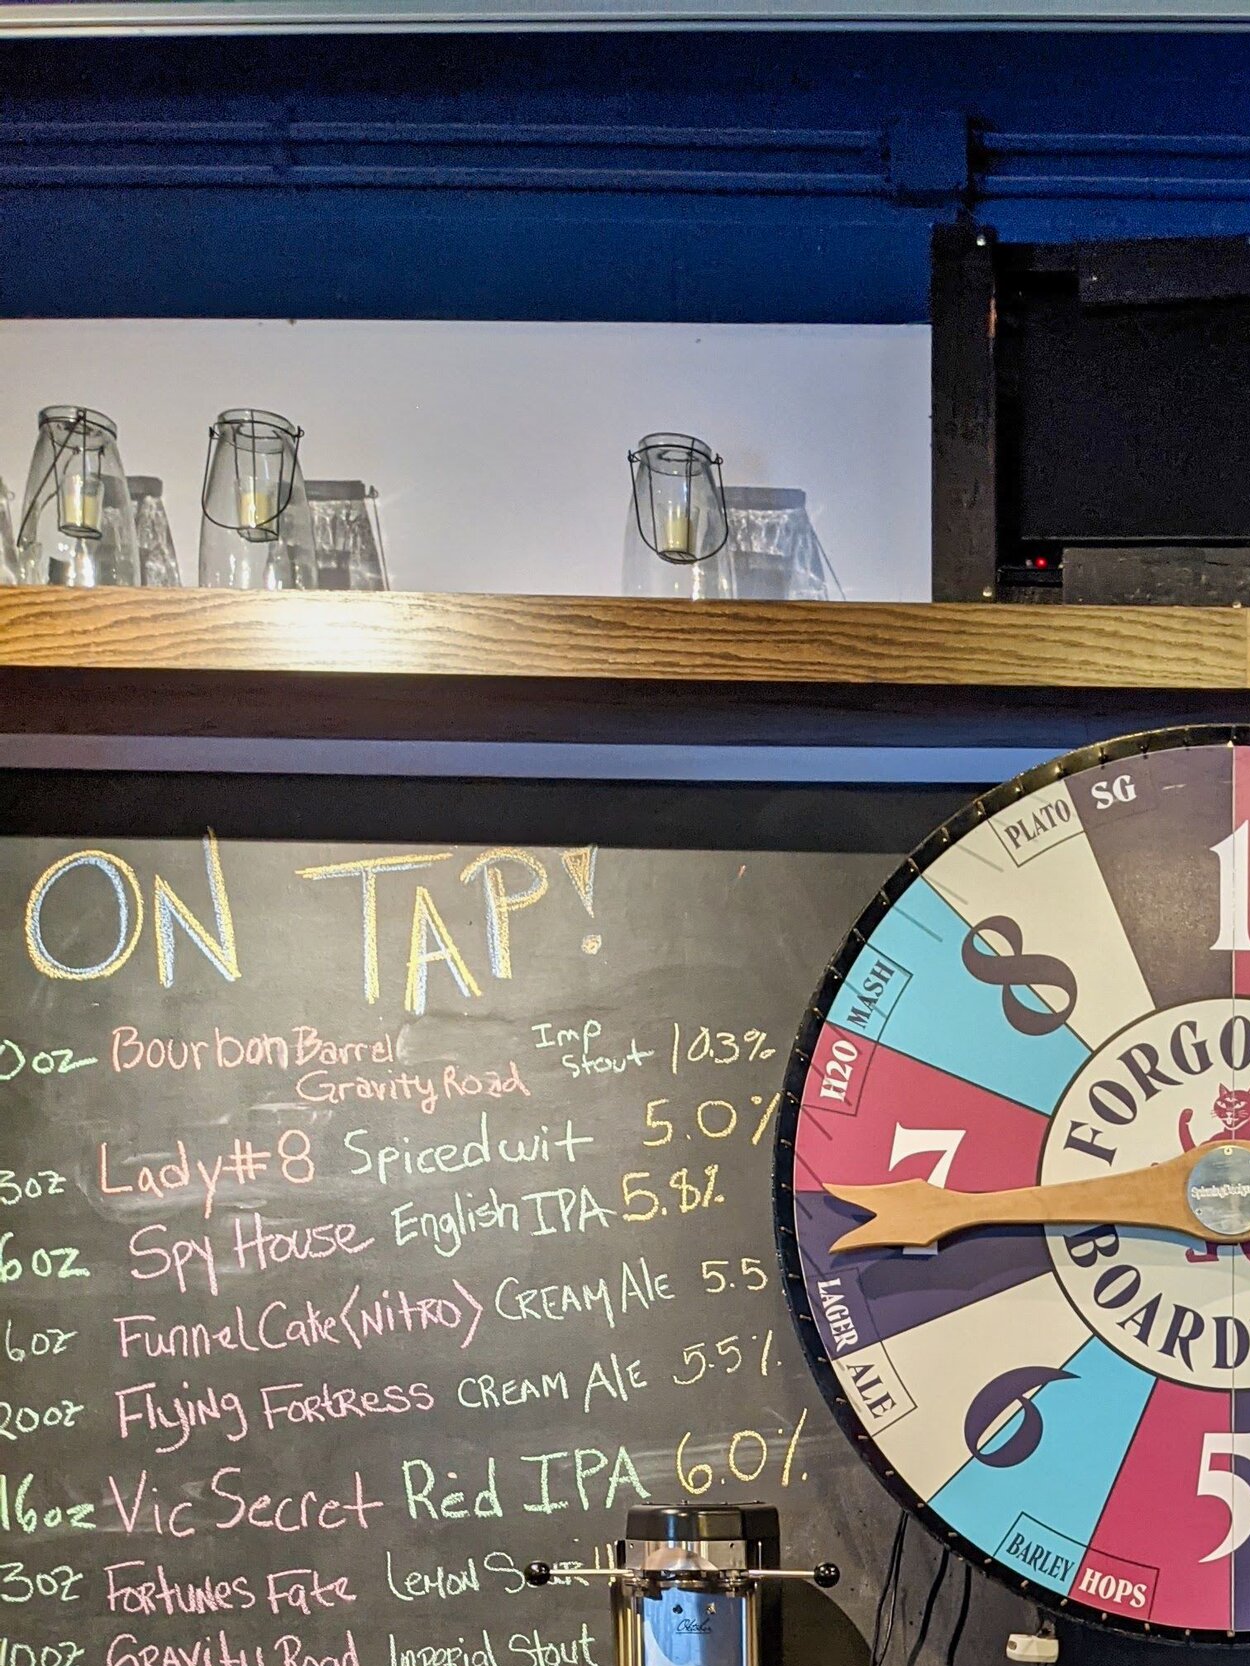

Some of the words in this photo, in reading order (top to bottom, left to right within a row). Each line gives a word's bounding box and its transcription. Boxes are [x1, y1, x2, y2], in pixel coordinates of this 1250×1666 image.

[1004, 799, 1071, 850] PLATO
[1091, 775, 1137, 810] SG
[25, 827, 242, 988] ON
[295, 846, 602, 1015] TAP!
[846, 960, 896, 1029] MASH
[962, 915, 1078, 1037] 8
[112, 1026, 289, 1072] Bourbon
[292, 1025, 395, 1066] Barrel
[532, 1019, 602, 1054] Imp
[296, 1070, 438, 1115] Gravity
[443, 1061, 532, 1098] Road
[888, 1121, 967, 1255] 7
[129, 1224, 218, 1296] Spy
[234, 1212, 375, 1270] House
[391, 1187, 519, 1258] English
[522, 1185, 618, 1236] IPA
[113, 1306, 259, 1357] Funnel
[702, 1258, 768, 1293] 5.5
[817, 1277, 859, 1352] LAGER
[846, 1362, 898, 1420] ALE
[964, 1366, 1082, 1469] 6
[109, 1470, 195, 1537] Vic
[212, 1467, 384, 1531] Secret
[402, 1457, 503, 1520] Red
[521, 1446, 651, 1514] IPA
[1006, 1532, 1075, 1583] BARLEY
[1078, 1567, 1148, 1609] HOPS
